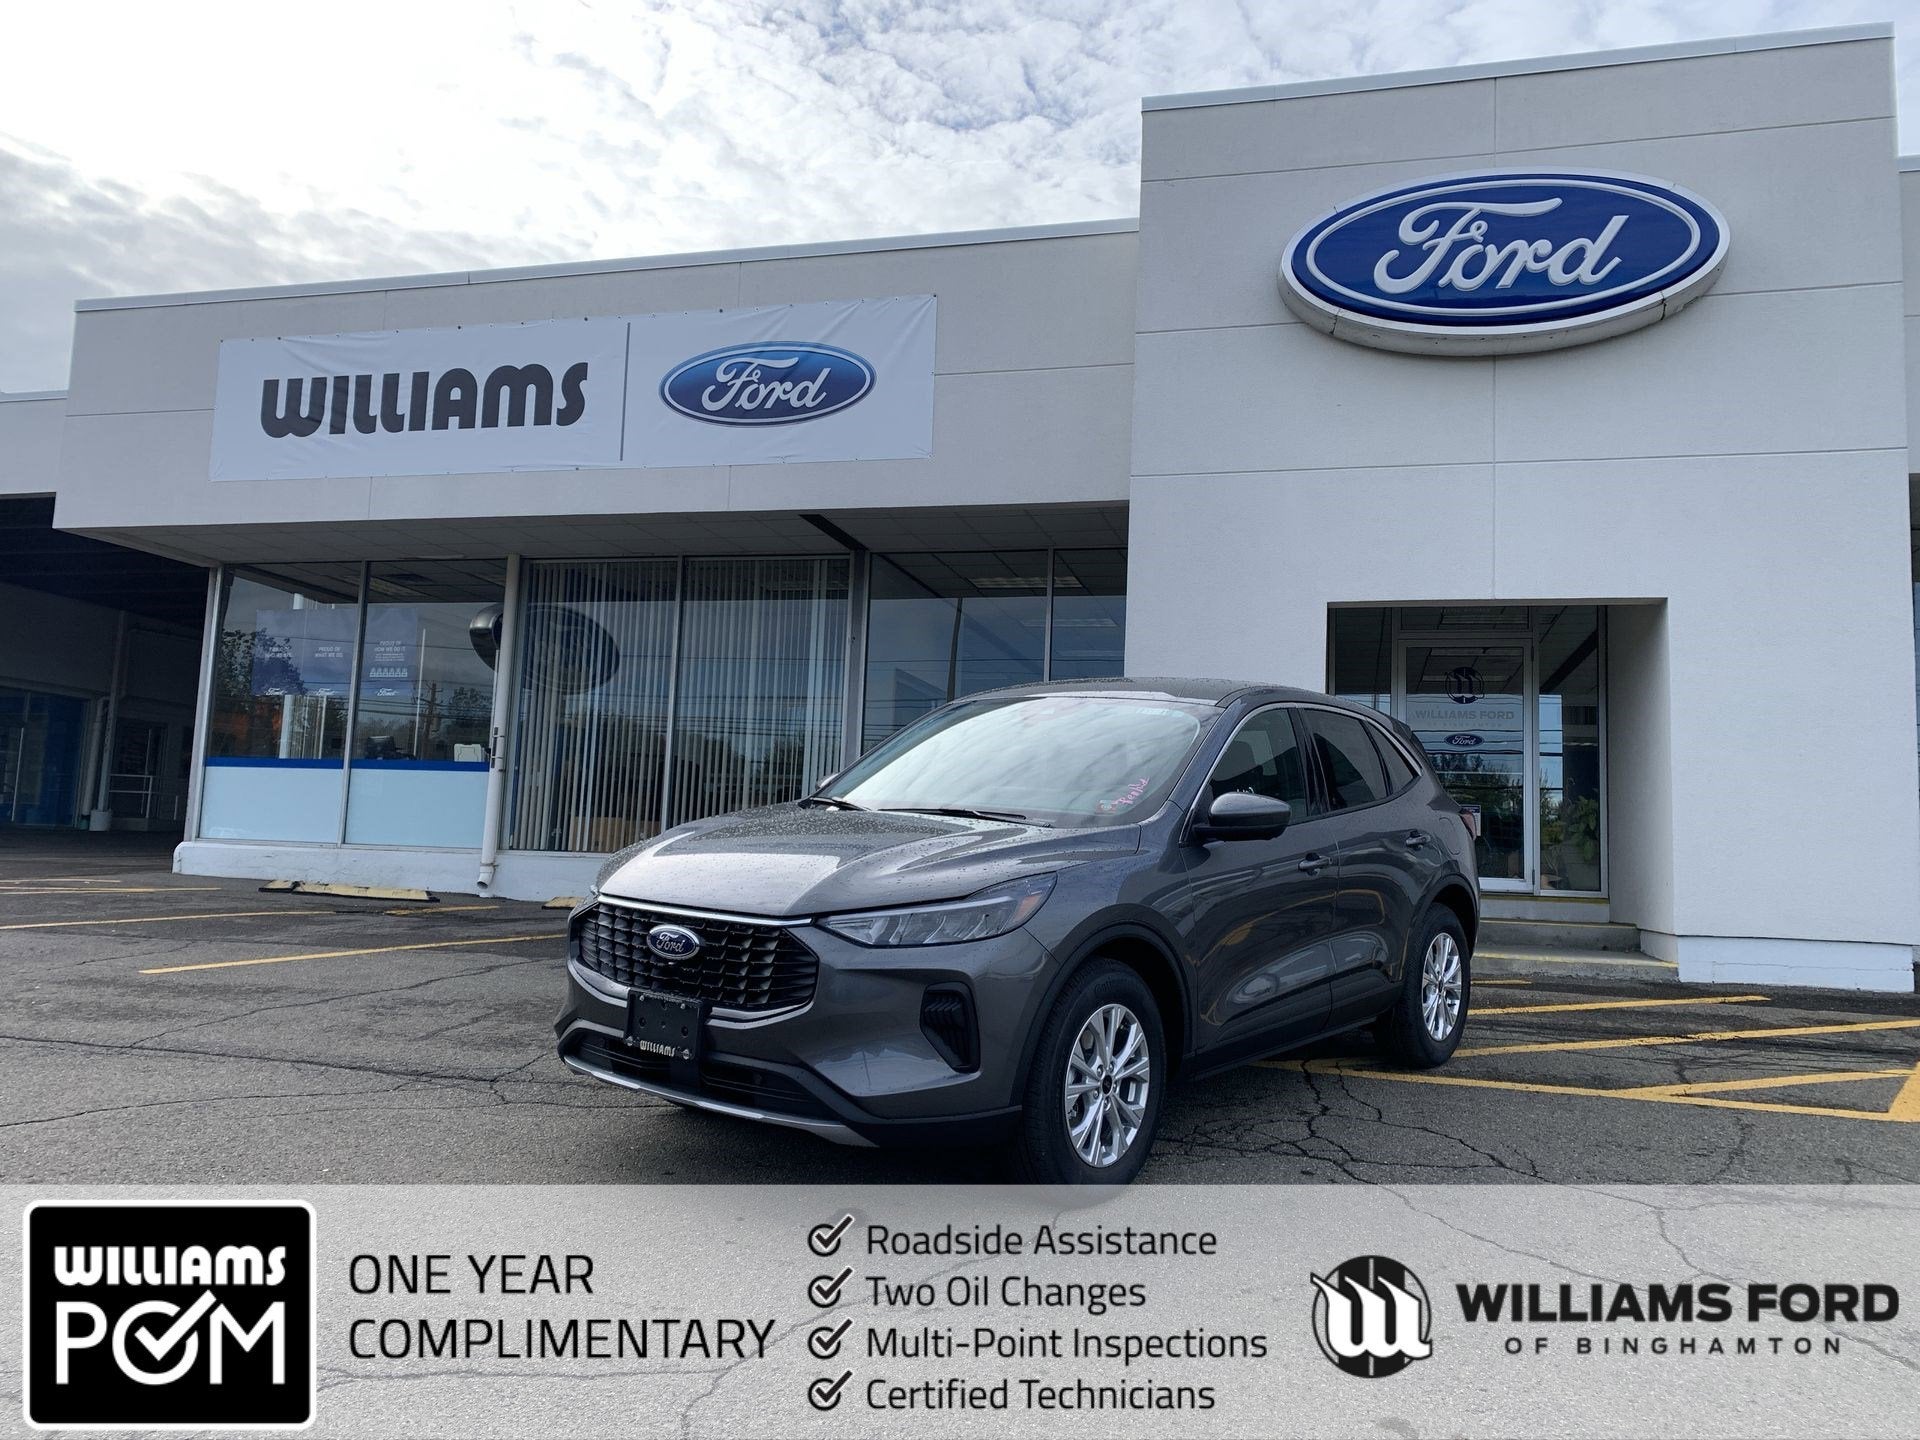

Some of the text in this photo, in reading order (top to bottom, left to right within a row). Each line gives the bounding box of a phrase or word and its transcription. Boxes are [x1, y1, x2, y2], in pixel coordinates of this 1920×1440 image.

[1373, 197, 1629, 294] Ford
[702, 355, 831, 412] Ford
[260, 362, 588, 438] WILLIAMS
[1414, 710, 1515, 720] WILLIAMS FORD
[1452, 735, 1477, 745] Ford
[656, 932, 685, 952] Ford
[639, 1040, 676, 1057] WILLIAMS
